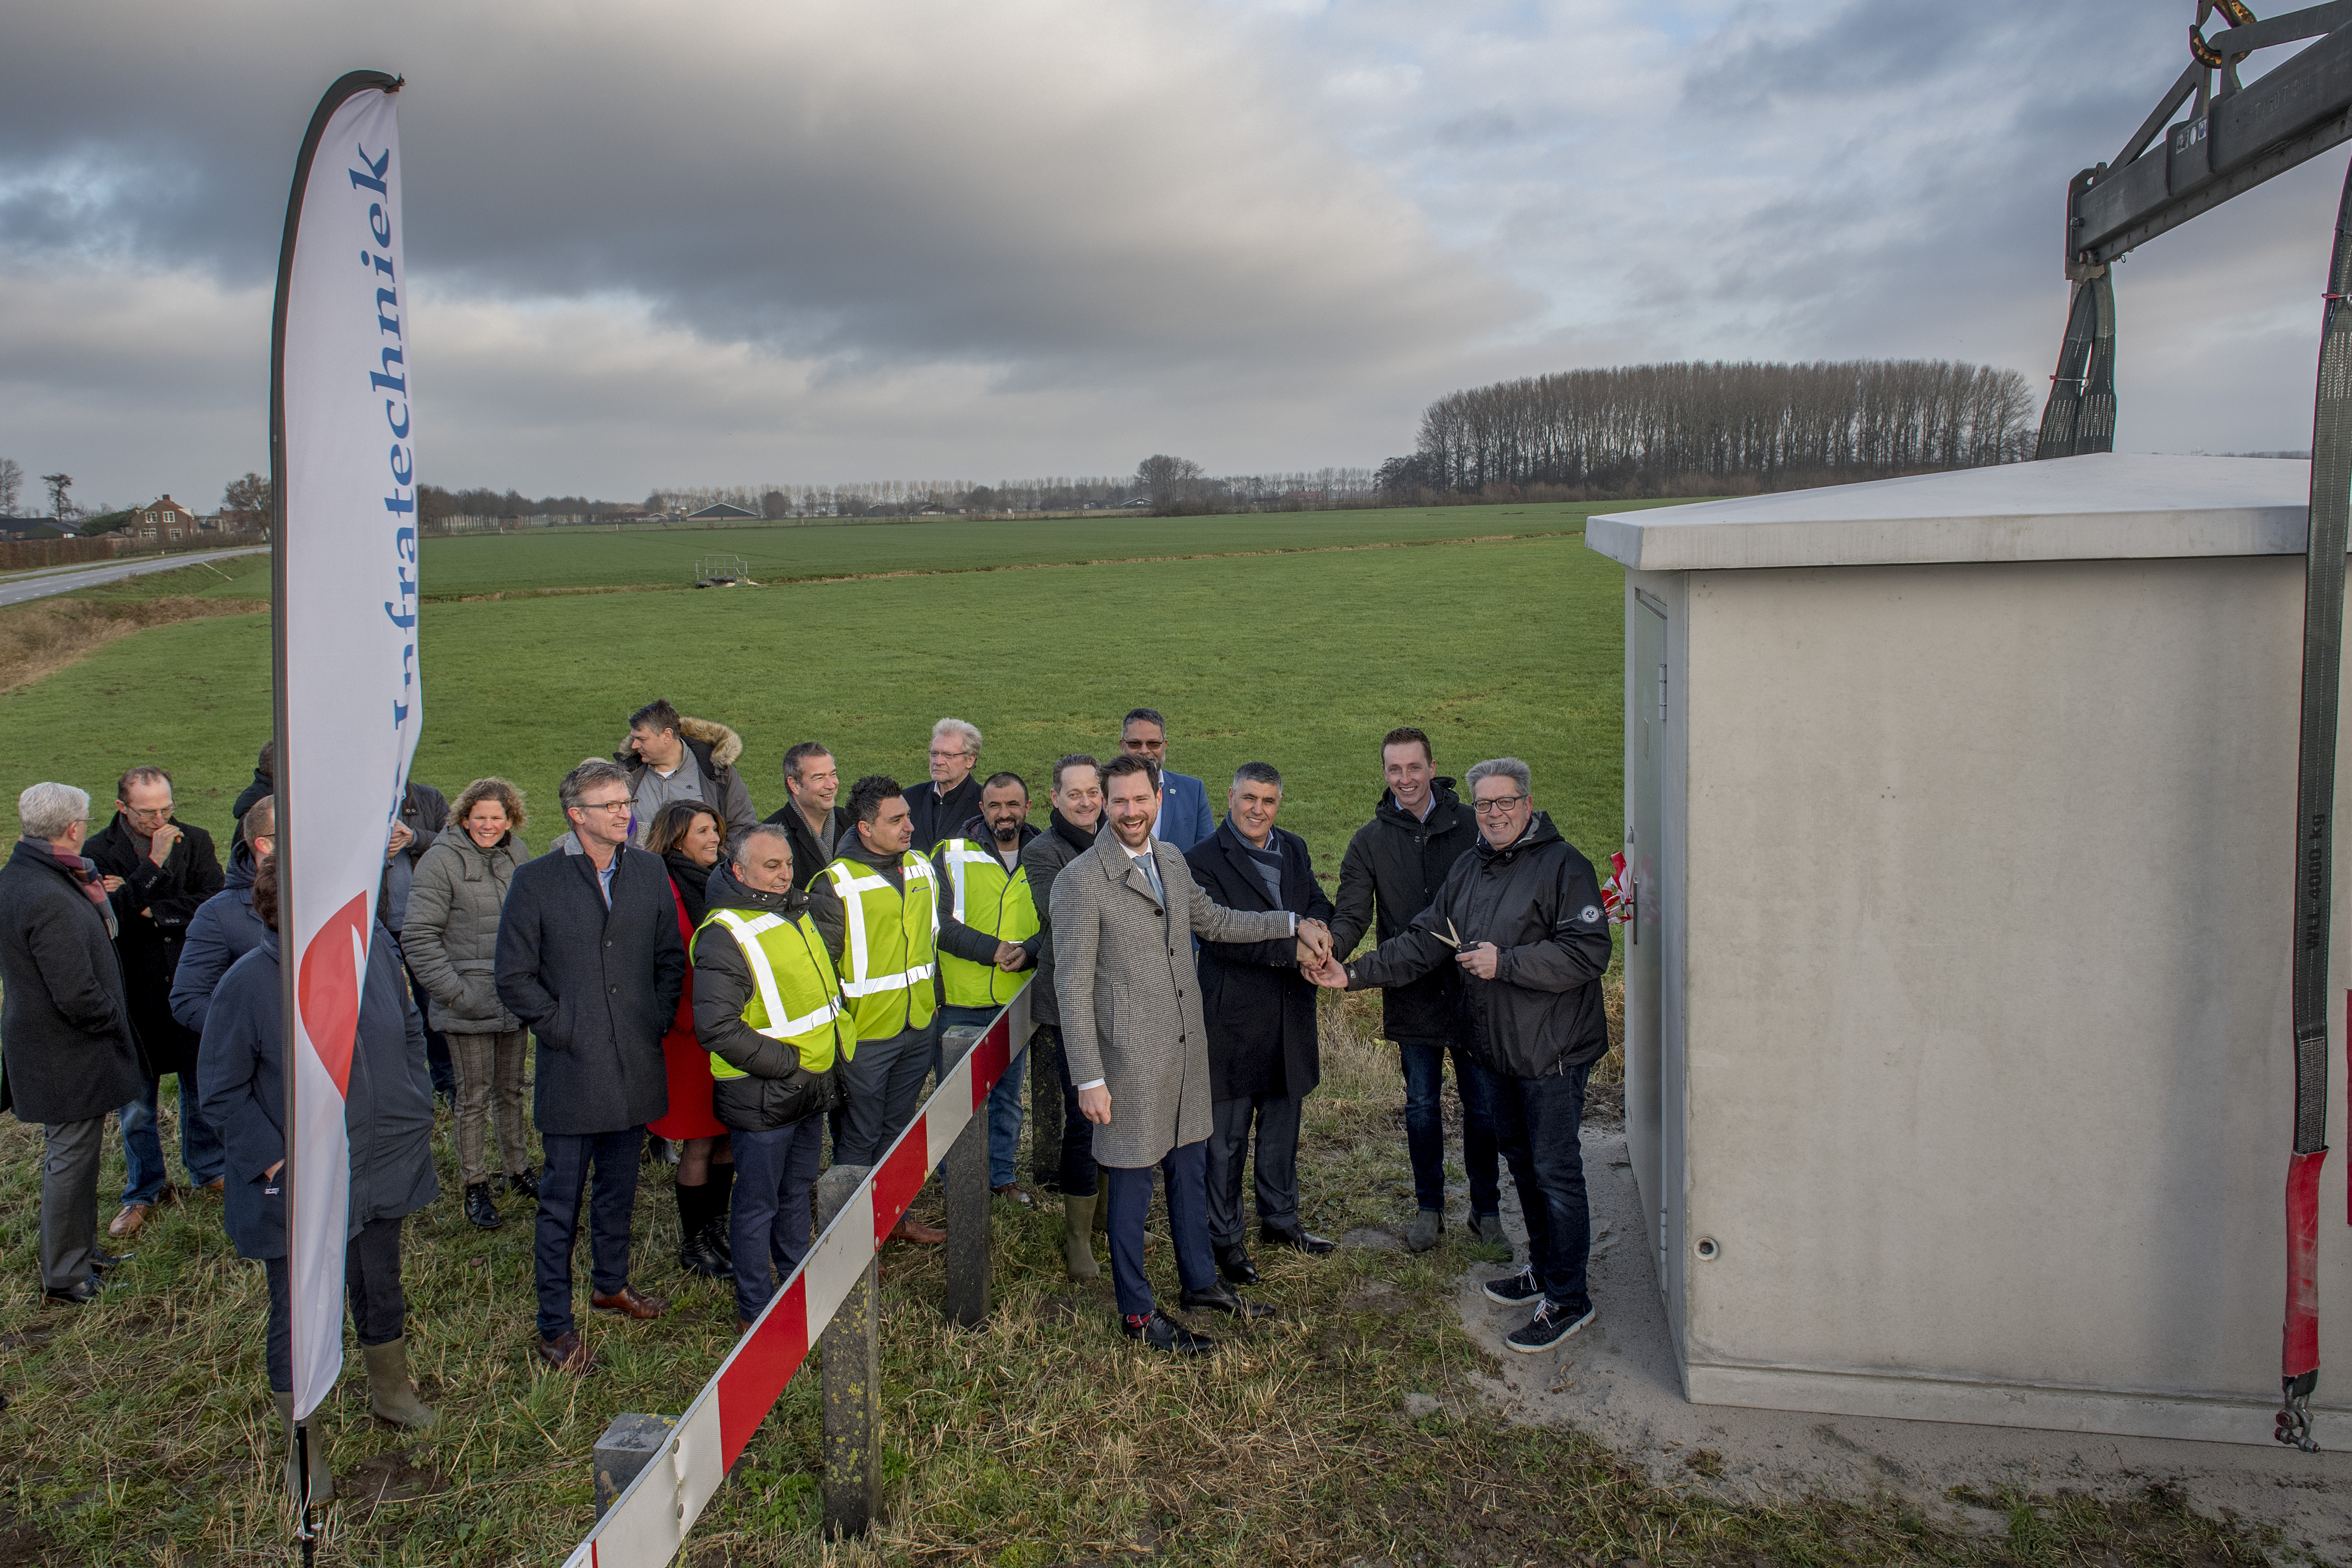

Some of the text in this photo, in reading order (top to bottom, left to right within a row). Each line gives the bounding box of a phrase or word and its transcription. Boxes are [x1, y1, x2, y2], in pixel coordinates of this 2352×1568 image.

[2306, 814, 2325, 951] WLL 4000 kg
